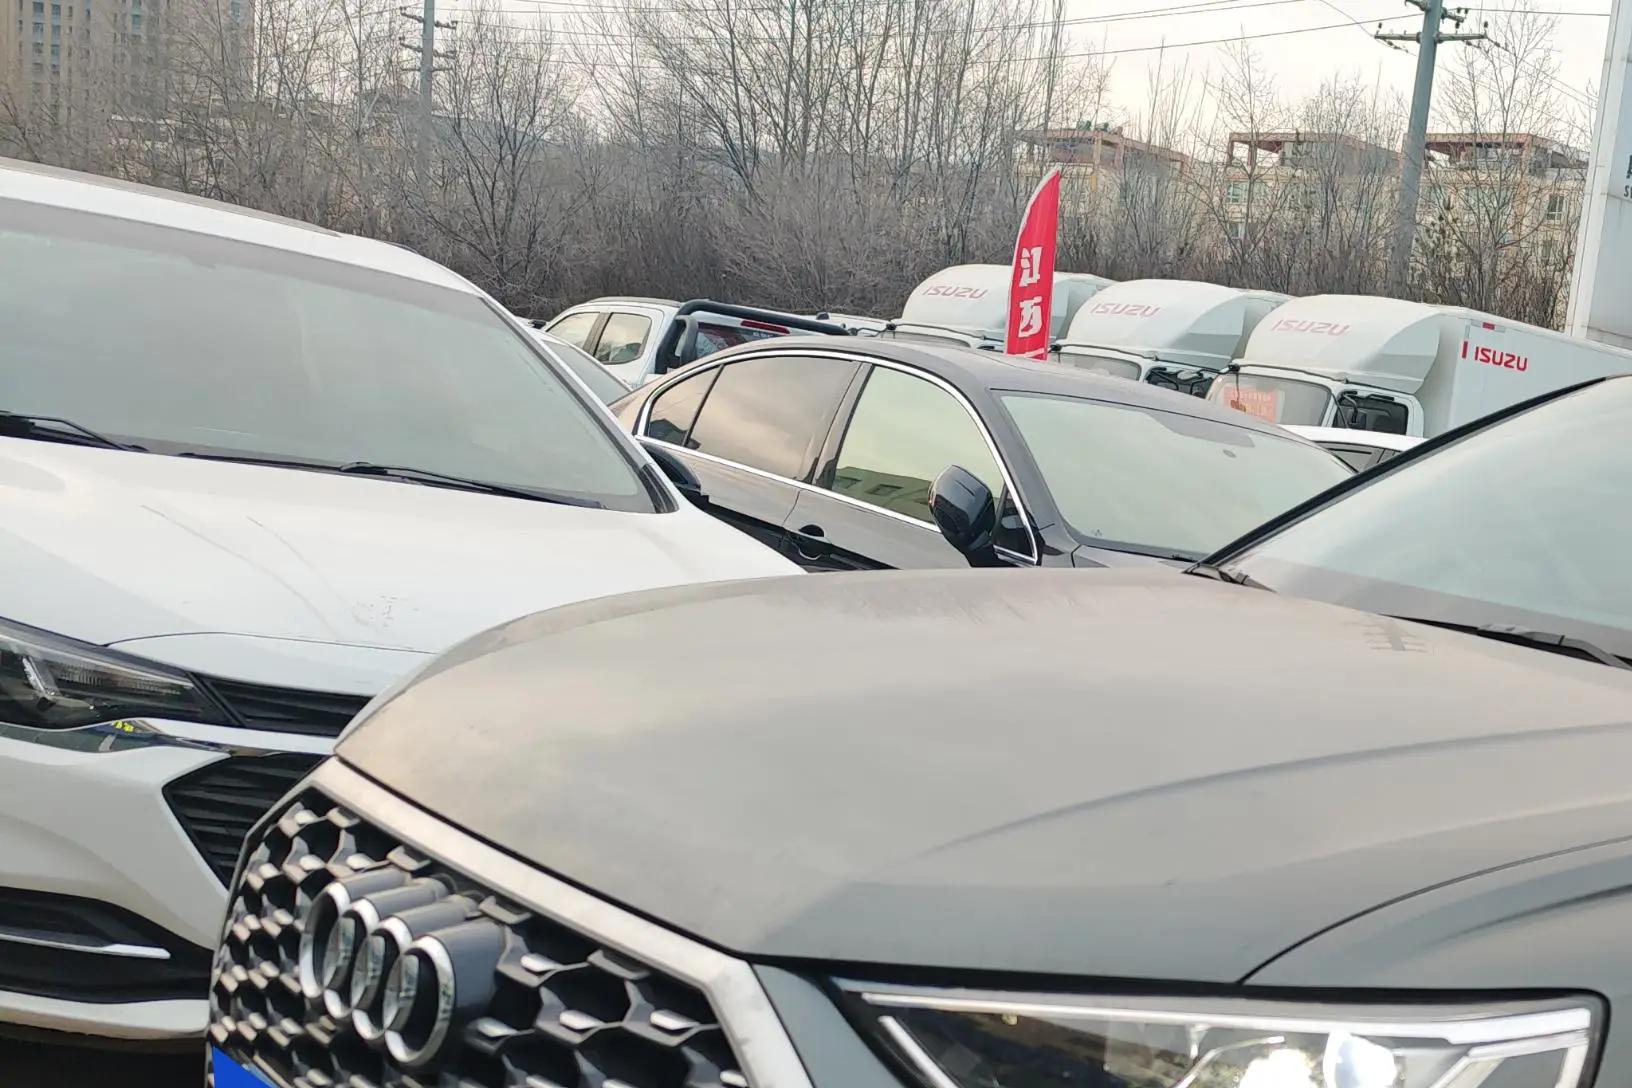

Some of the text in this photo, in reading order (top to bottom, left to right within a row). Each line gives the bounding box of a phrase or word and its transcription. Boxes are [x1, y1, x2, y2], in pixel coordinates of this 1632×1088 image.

[922, 285, 988, 300] ISUZU
[1091, 303, 1160, 318] ISUZU
[1271, 319, 1349, 336] ISUZU
[1474, 346, 1528, 372] ISUZU
